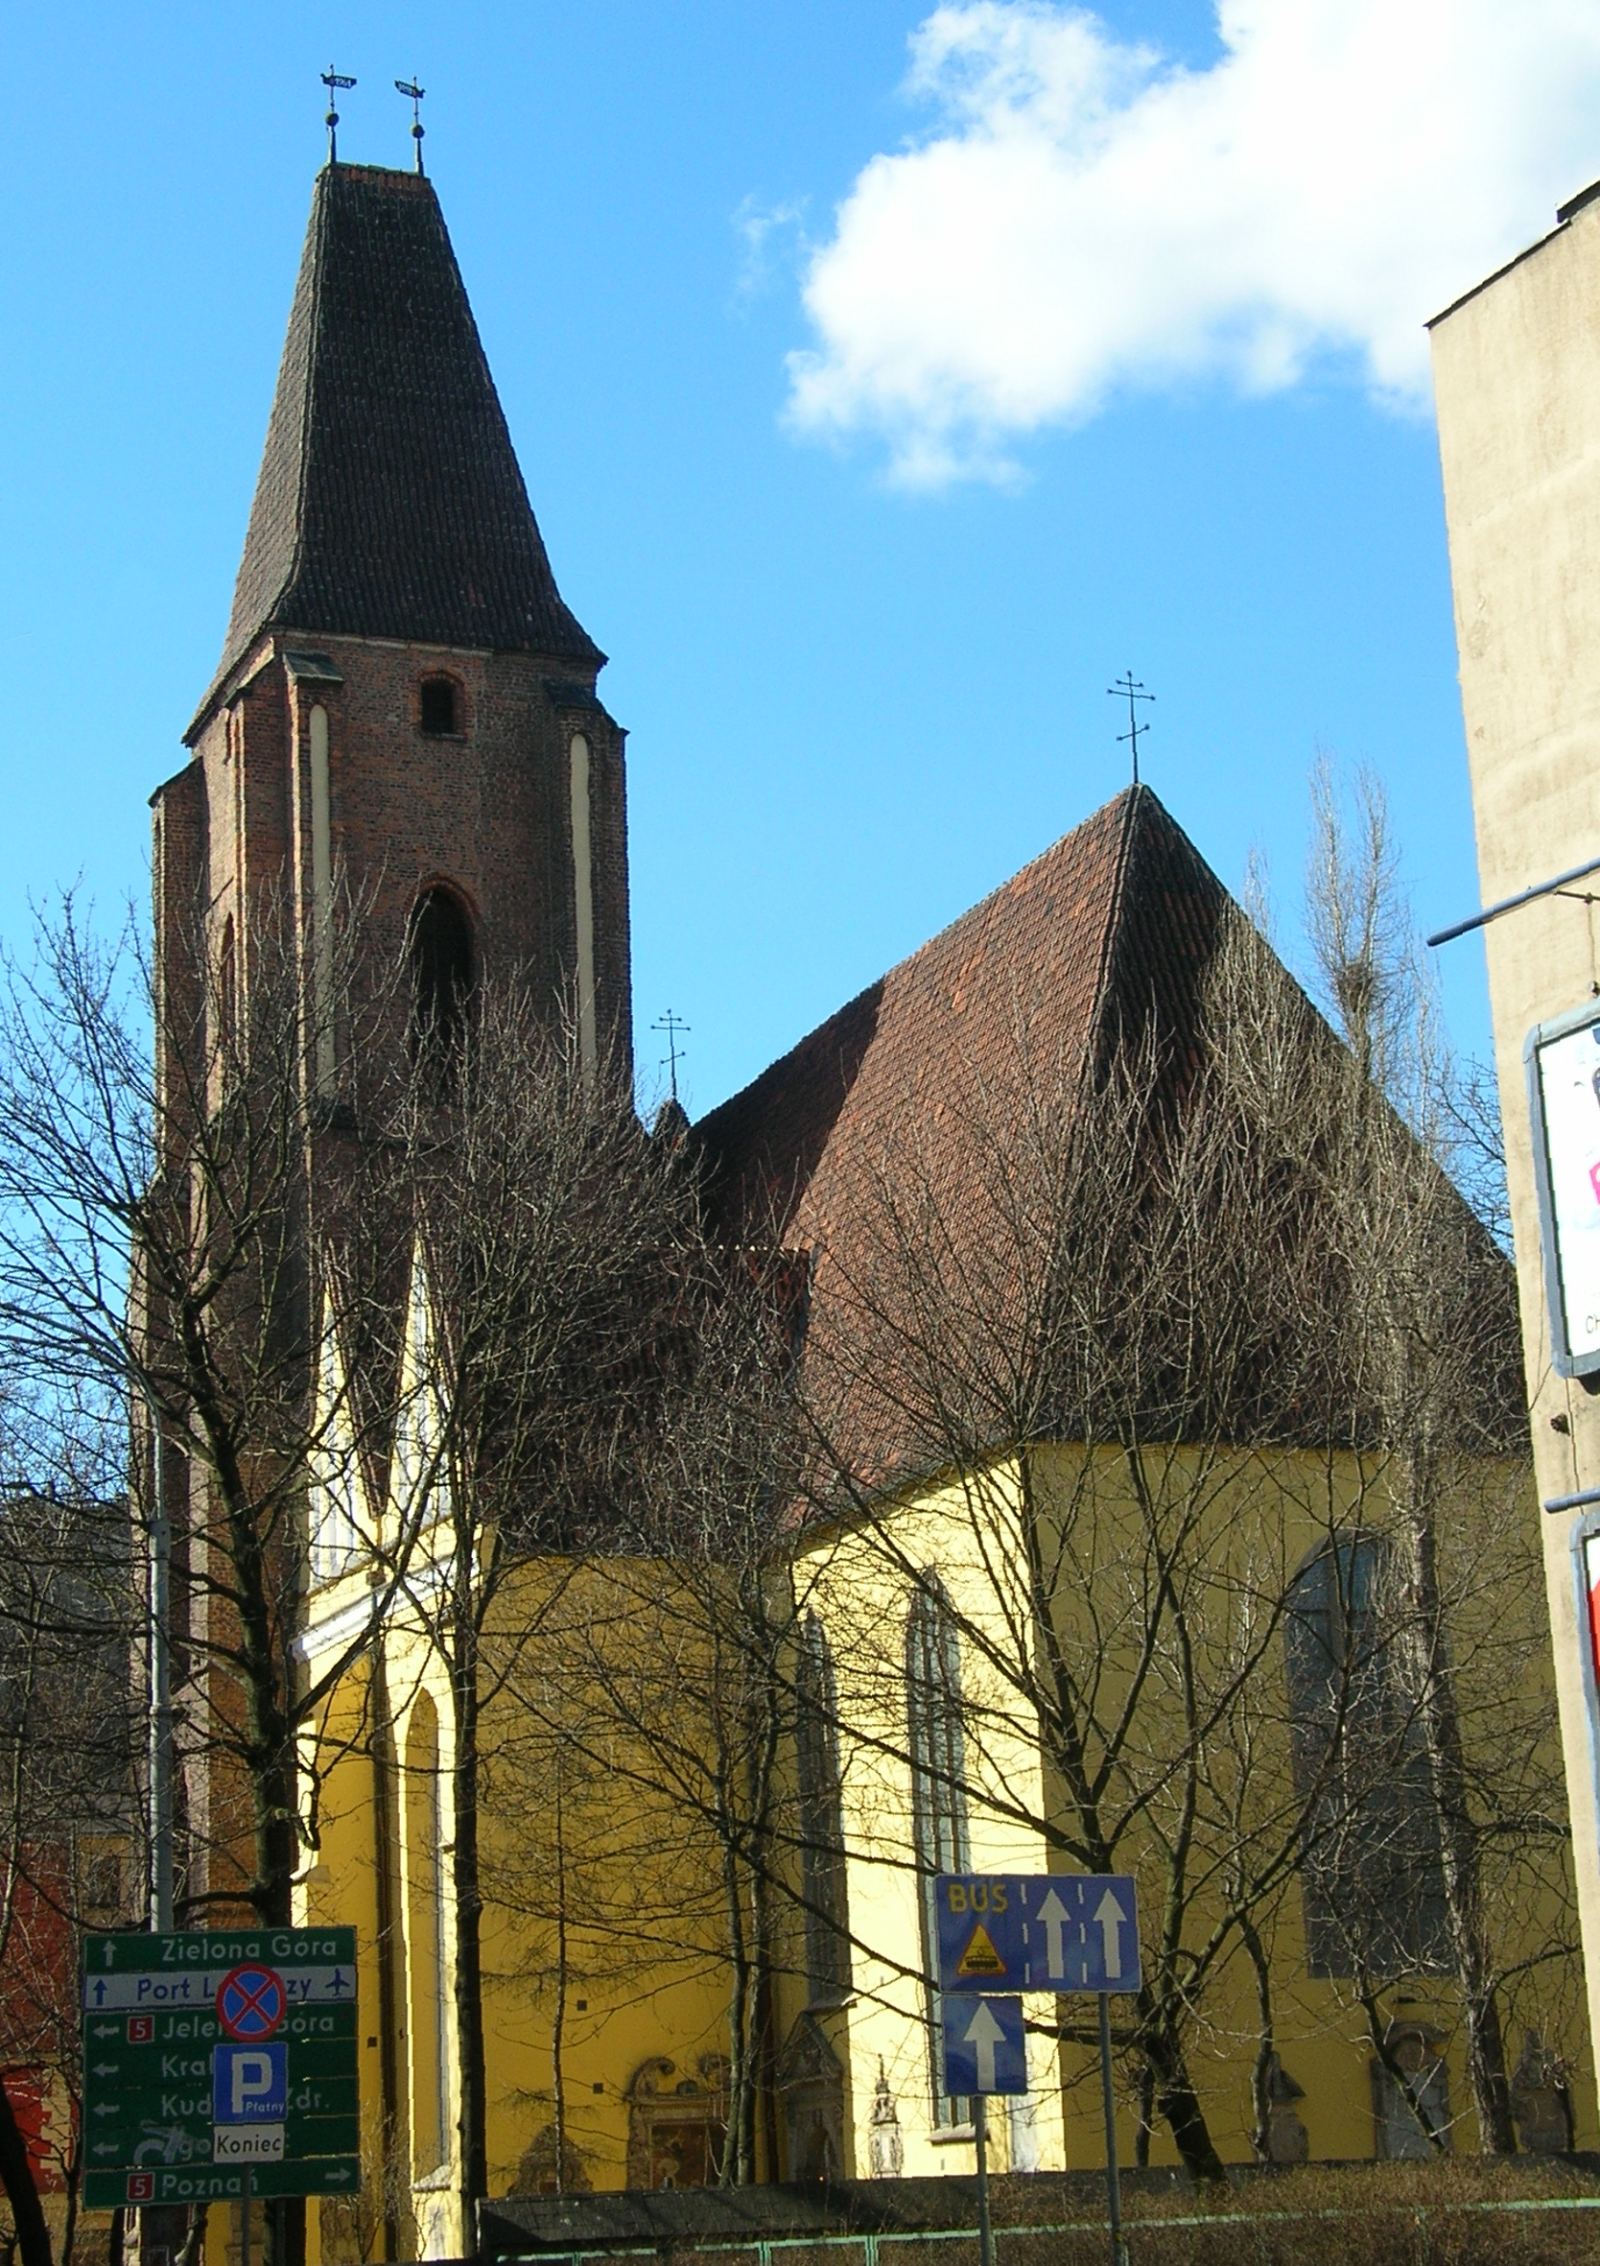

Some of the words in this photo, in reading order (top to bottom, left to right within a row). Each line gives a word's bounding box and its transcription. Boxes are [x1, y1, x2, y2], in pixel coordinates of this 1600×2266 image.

[947, 1883, 1009, 1914] BUS
[161, 1938, 260, 1961] Zielona
[271, 1934, 336, 1957] Góra
[137, 1977, 190, 2001] Port
[135, 2020, 146, 2039] 5
[162, 2015, 228, 2039] Jele
[231, 2052, 273, 2114] P
[245, 2100, 285, 2114] Płatny
[217, 2134, 281, 2154] Koniec
[134, 2178, 146, 2197] 5
[161, 2168, 259, 2198] Poznań
